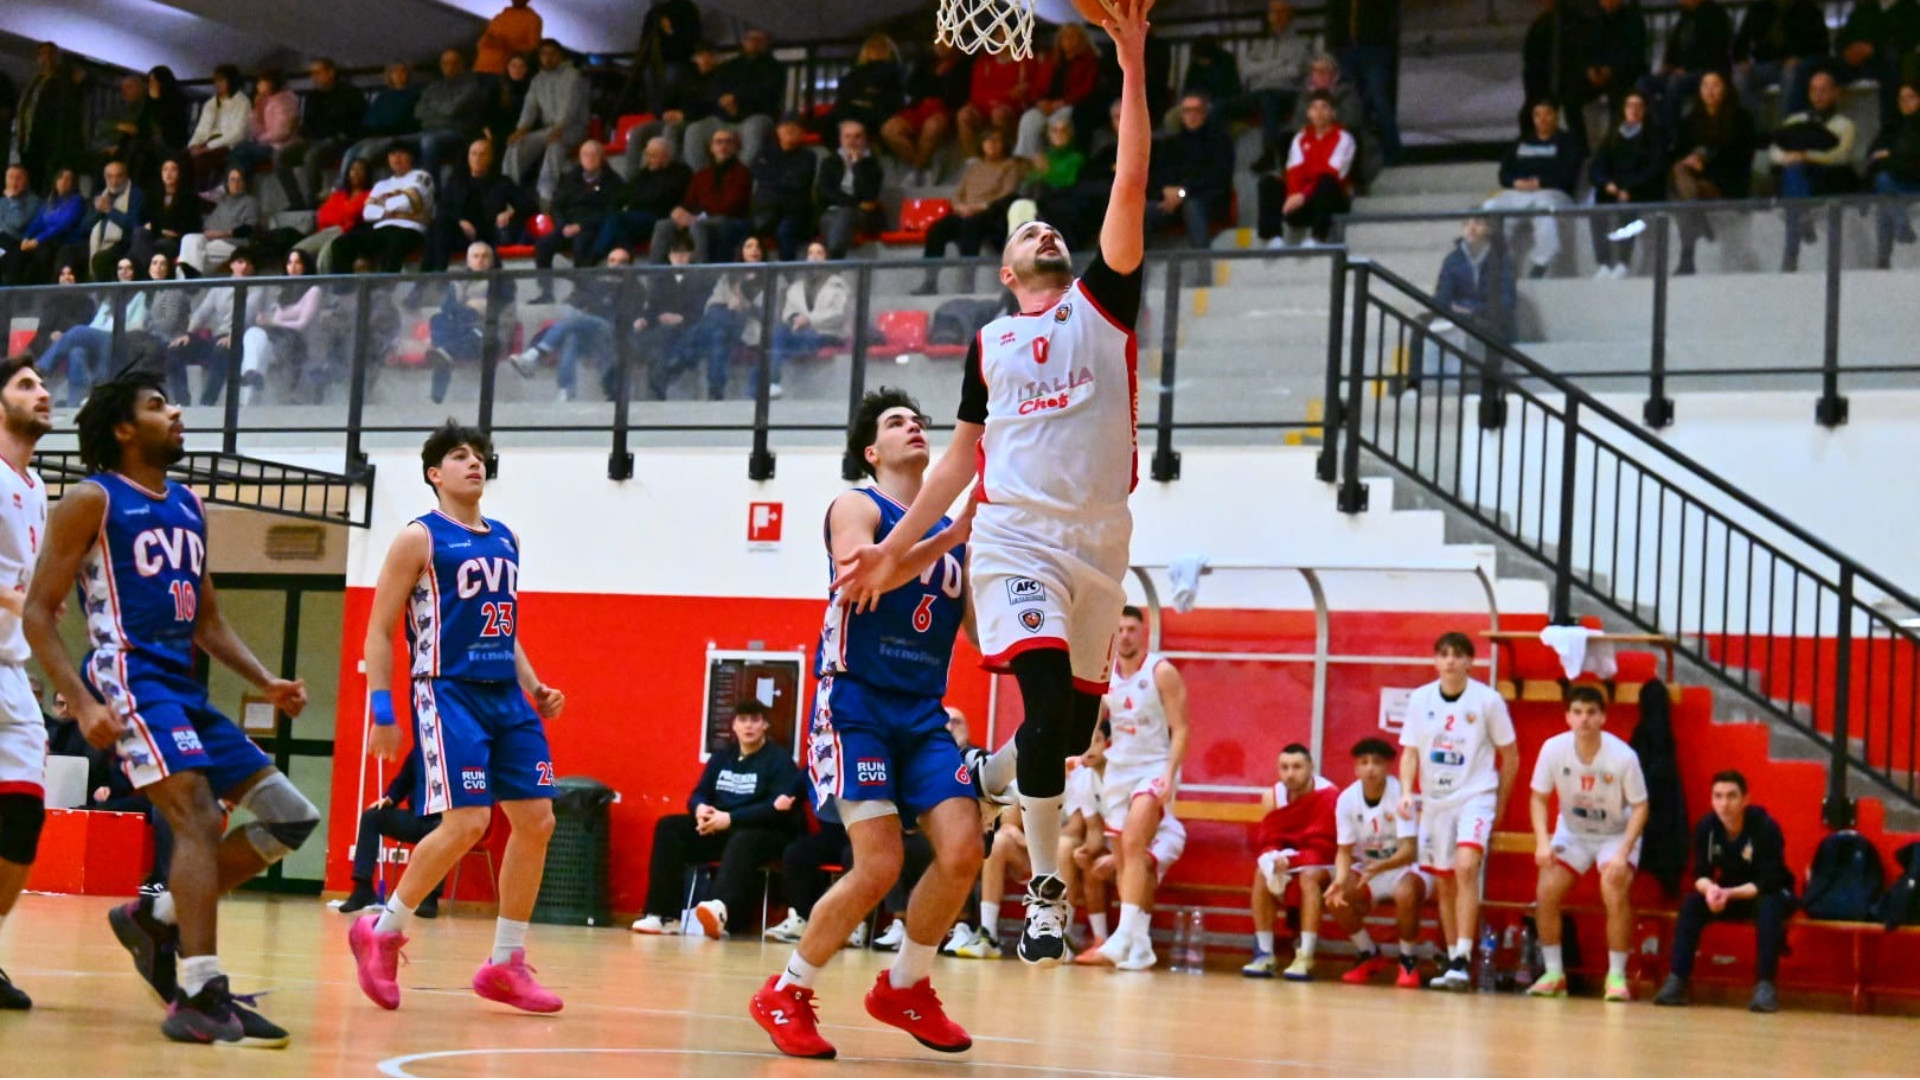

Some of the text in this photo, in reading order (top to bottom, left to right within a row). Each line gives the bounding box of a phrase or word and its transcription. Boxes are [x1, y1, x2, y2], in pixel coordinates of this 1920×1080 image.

[1032, 335, 1049, 364] 0
[1017, 367, 1095, 402] ITALIA
[133, 527, 205, 577] CVD
[1016, 581, 1037, 593] AFC
[168, 579, 197, 622] 10
[479, 601, 514, 637] 23
[912, 594, 938, 633] 6
[462, 771, 486, 781] RUN
[857, 762, 886, 772] RUN
[858, 771, 887, 782] CVD
[955, 764, 971, 785] 6
[463, 780, 486, 790] CVD
